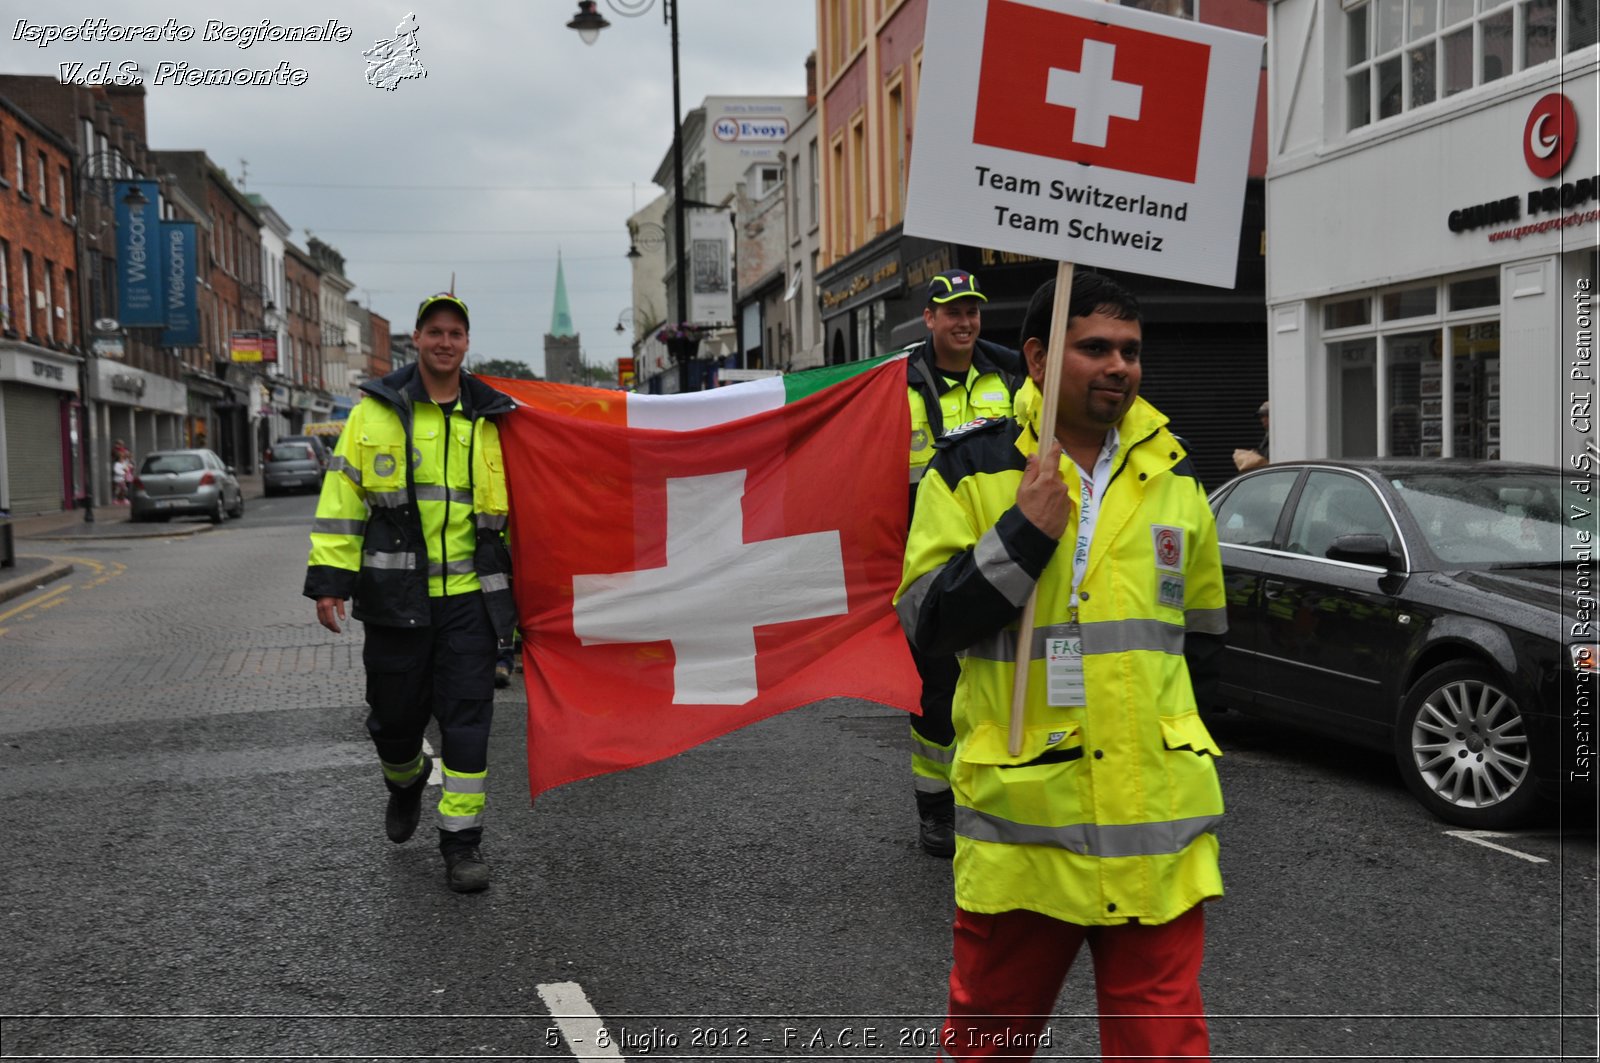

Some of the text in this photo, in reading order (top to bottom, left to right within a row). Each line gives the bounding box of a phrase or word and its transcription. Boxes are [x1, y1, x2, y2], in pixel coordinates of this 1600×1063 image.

[742, 123, 785, 137] Evoys
[975, 166, 1188, 222] Team Switzerland
[994, 205, 1164, 252] Team Schweiz
[168, 229, 185, 310] Welcome
